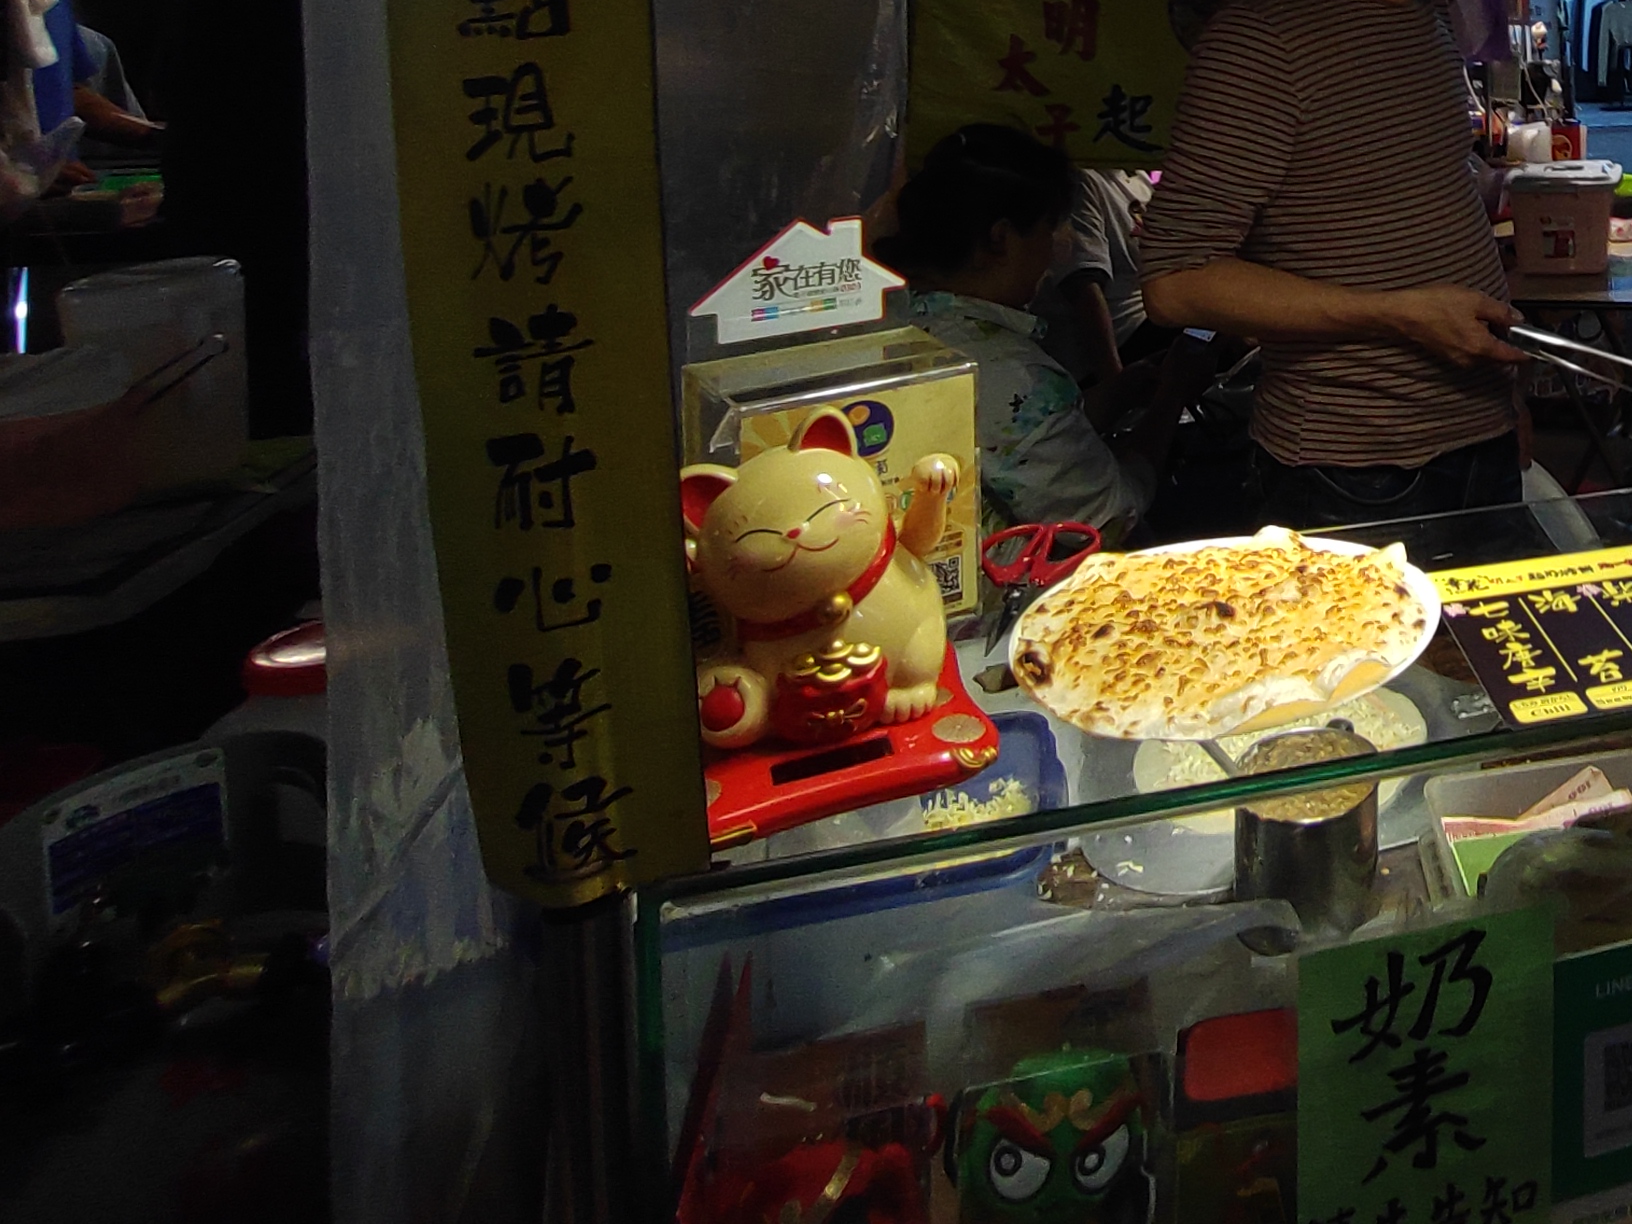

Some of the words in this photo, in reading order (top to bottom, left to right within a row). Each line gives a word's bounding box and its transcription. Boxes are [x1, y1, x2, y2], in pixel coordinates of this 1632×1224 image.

[750, 257, 864, 301] 家在有您
[1527, 589, 1624, 682] 海苔
[1531, 704, 1571, 717] Chili
[1331, 929, 1495, 1186] 奶素
